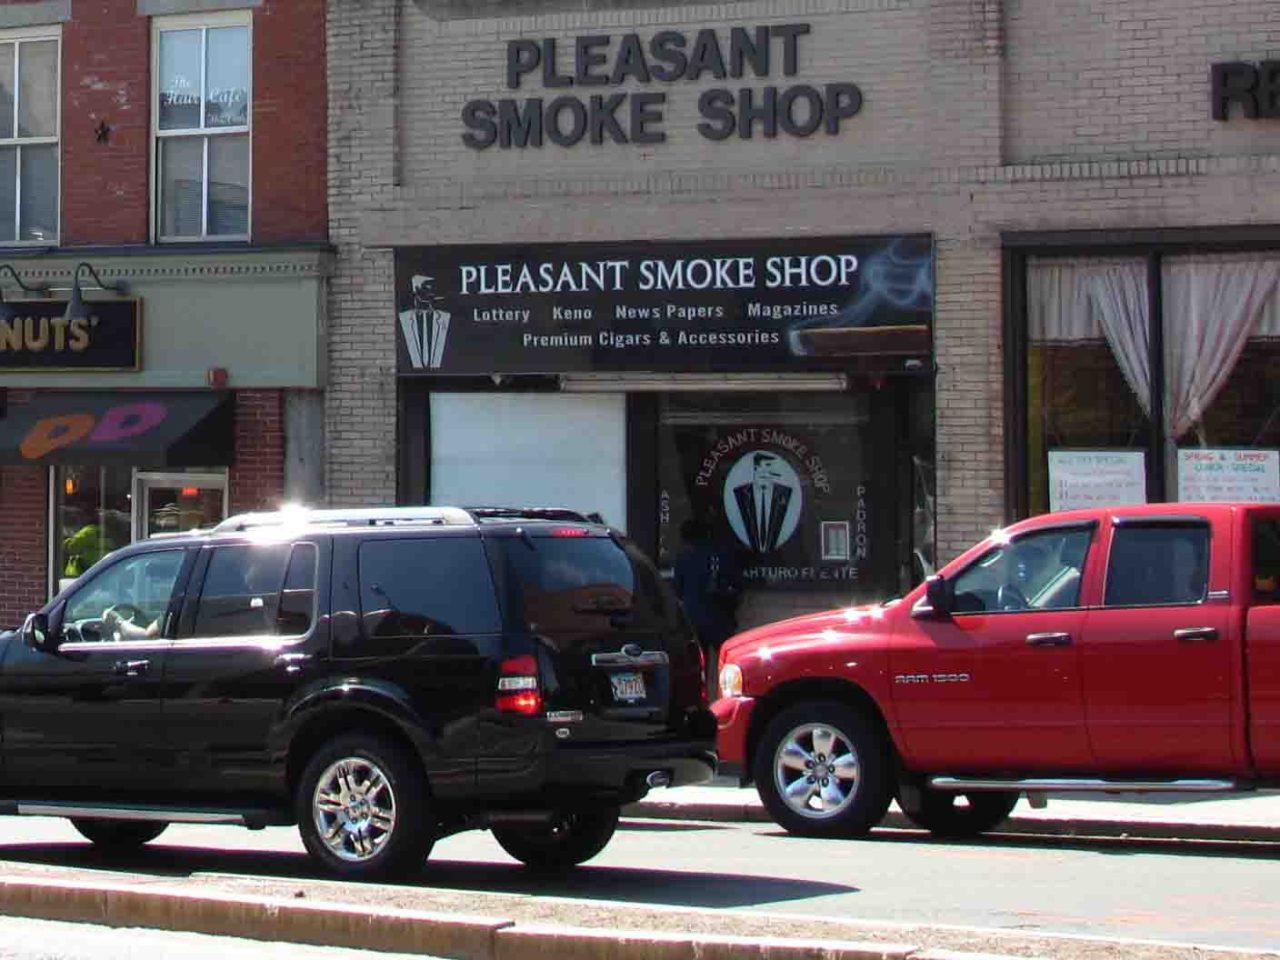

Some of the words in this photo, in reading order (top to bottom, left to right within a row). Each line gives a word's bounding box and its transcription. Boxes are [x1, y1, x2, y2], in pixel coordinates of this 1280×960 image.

[506, 23, 811, 88] PLEASANT
[461, 92, 667, 150] SMOKE
[697, 82, 864, 140] SHOP
[459, 260, 630, 295] PLEASANT
[638, 256, 757, 291] SMOKE
[765, 254, 859, 288] SHOP
[473, 306, 531, 324] Lottery
[552, 305, 593, 321] Keno
[615, 303, 661, 320] News
[666, 302, 724, 321] Papers
[747, 300, 839, 320] Magazines
[523, 332, 593, 348] Premium
[599, 330, 651, 349] Cigars
[659, 330, 670, 345] &
[676, 328, 780, 347] Accessories
[695, 428, 761, 486] PLEASANT
[763, 428, 805, 458] SMOKE
[806, 455, 830, 494] SHOP
[895, 675, 929, 684] RAM
